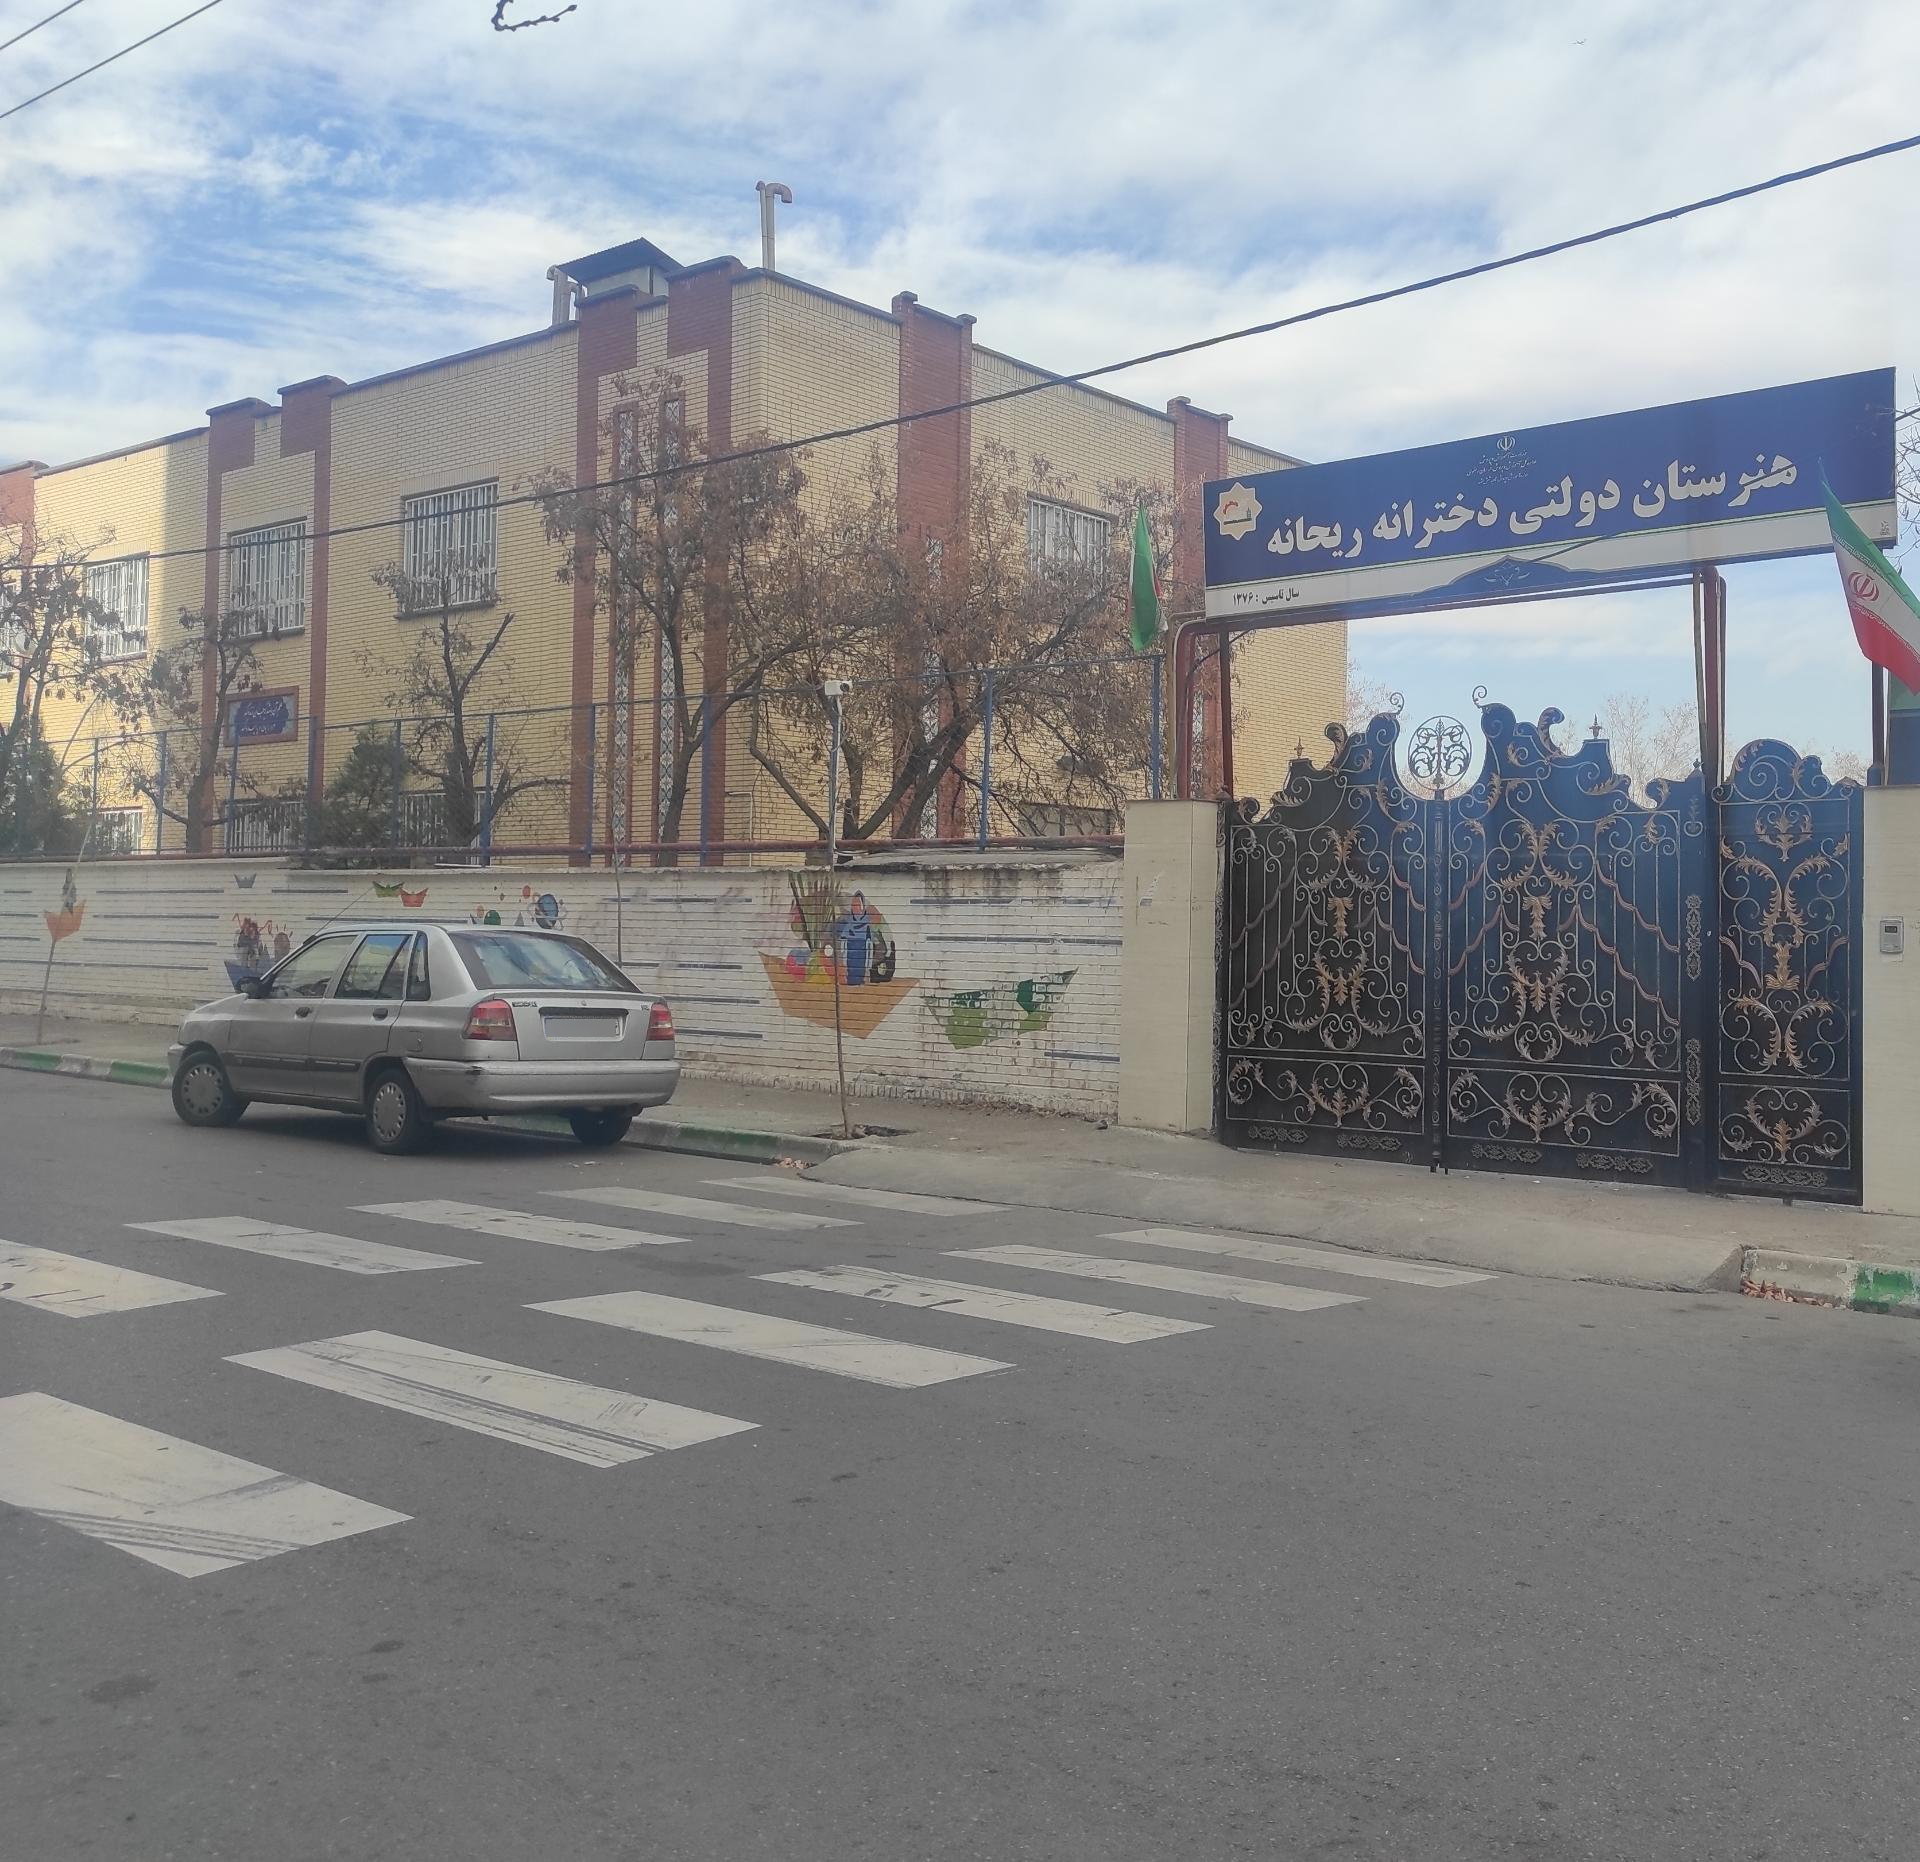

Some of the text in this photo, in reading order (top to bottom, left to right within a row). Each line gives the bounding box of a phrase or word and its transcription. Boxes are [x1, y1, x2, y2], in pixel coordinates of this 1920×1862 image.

[1266, 453, 1798, 559] هنرستان دولتی دخترانه ریحانه
[1232, 591, 1254, 607] ۱۳۷۶
[1285, 586, 1300, 602] سال
